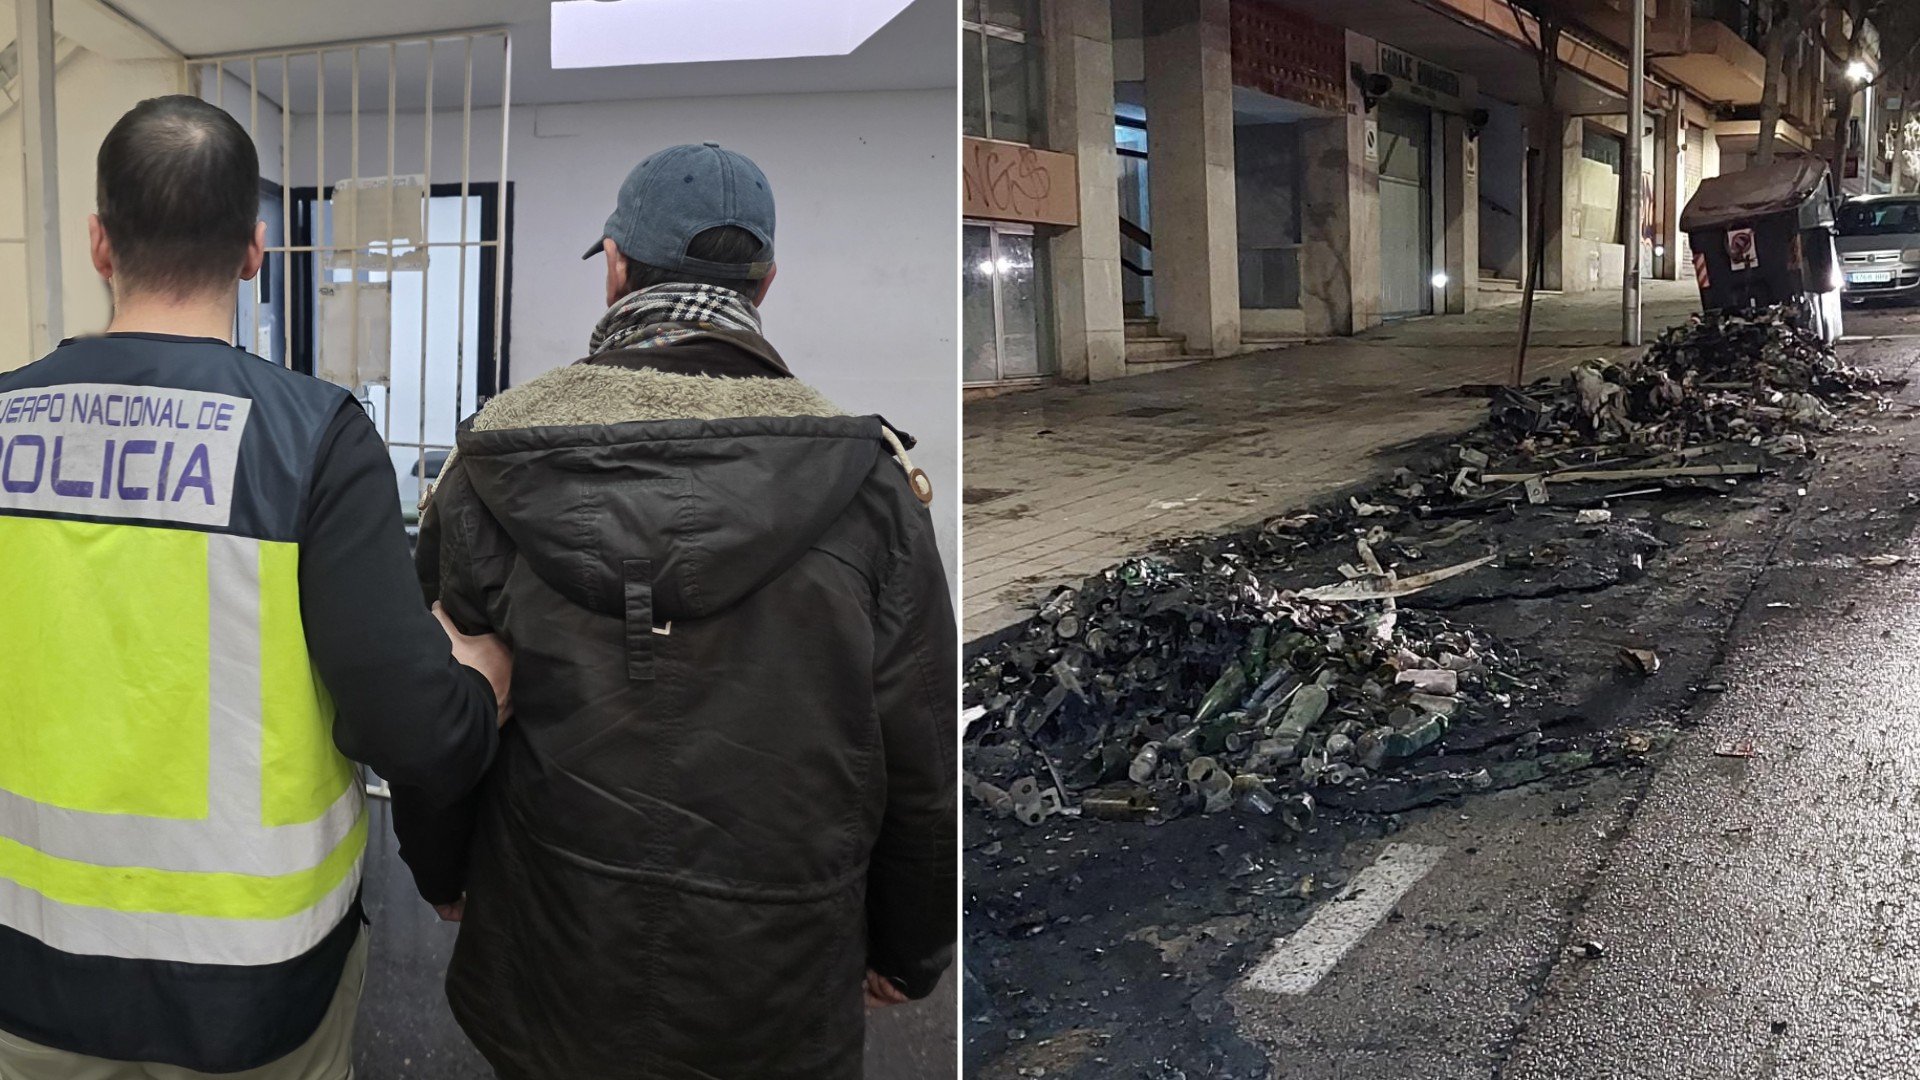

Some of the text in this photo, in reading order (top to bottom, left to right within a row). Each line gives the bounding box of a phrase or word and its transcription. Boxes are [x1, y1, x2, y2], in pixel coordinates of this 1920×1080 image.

[70, 393, 189, 428] NACIONAL
[196, 401, 235, 431] DE
[0, 434, 215, 505] OLICIA
